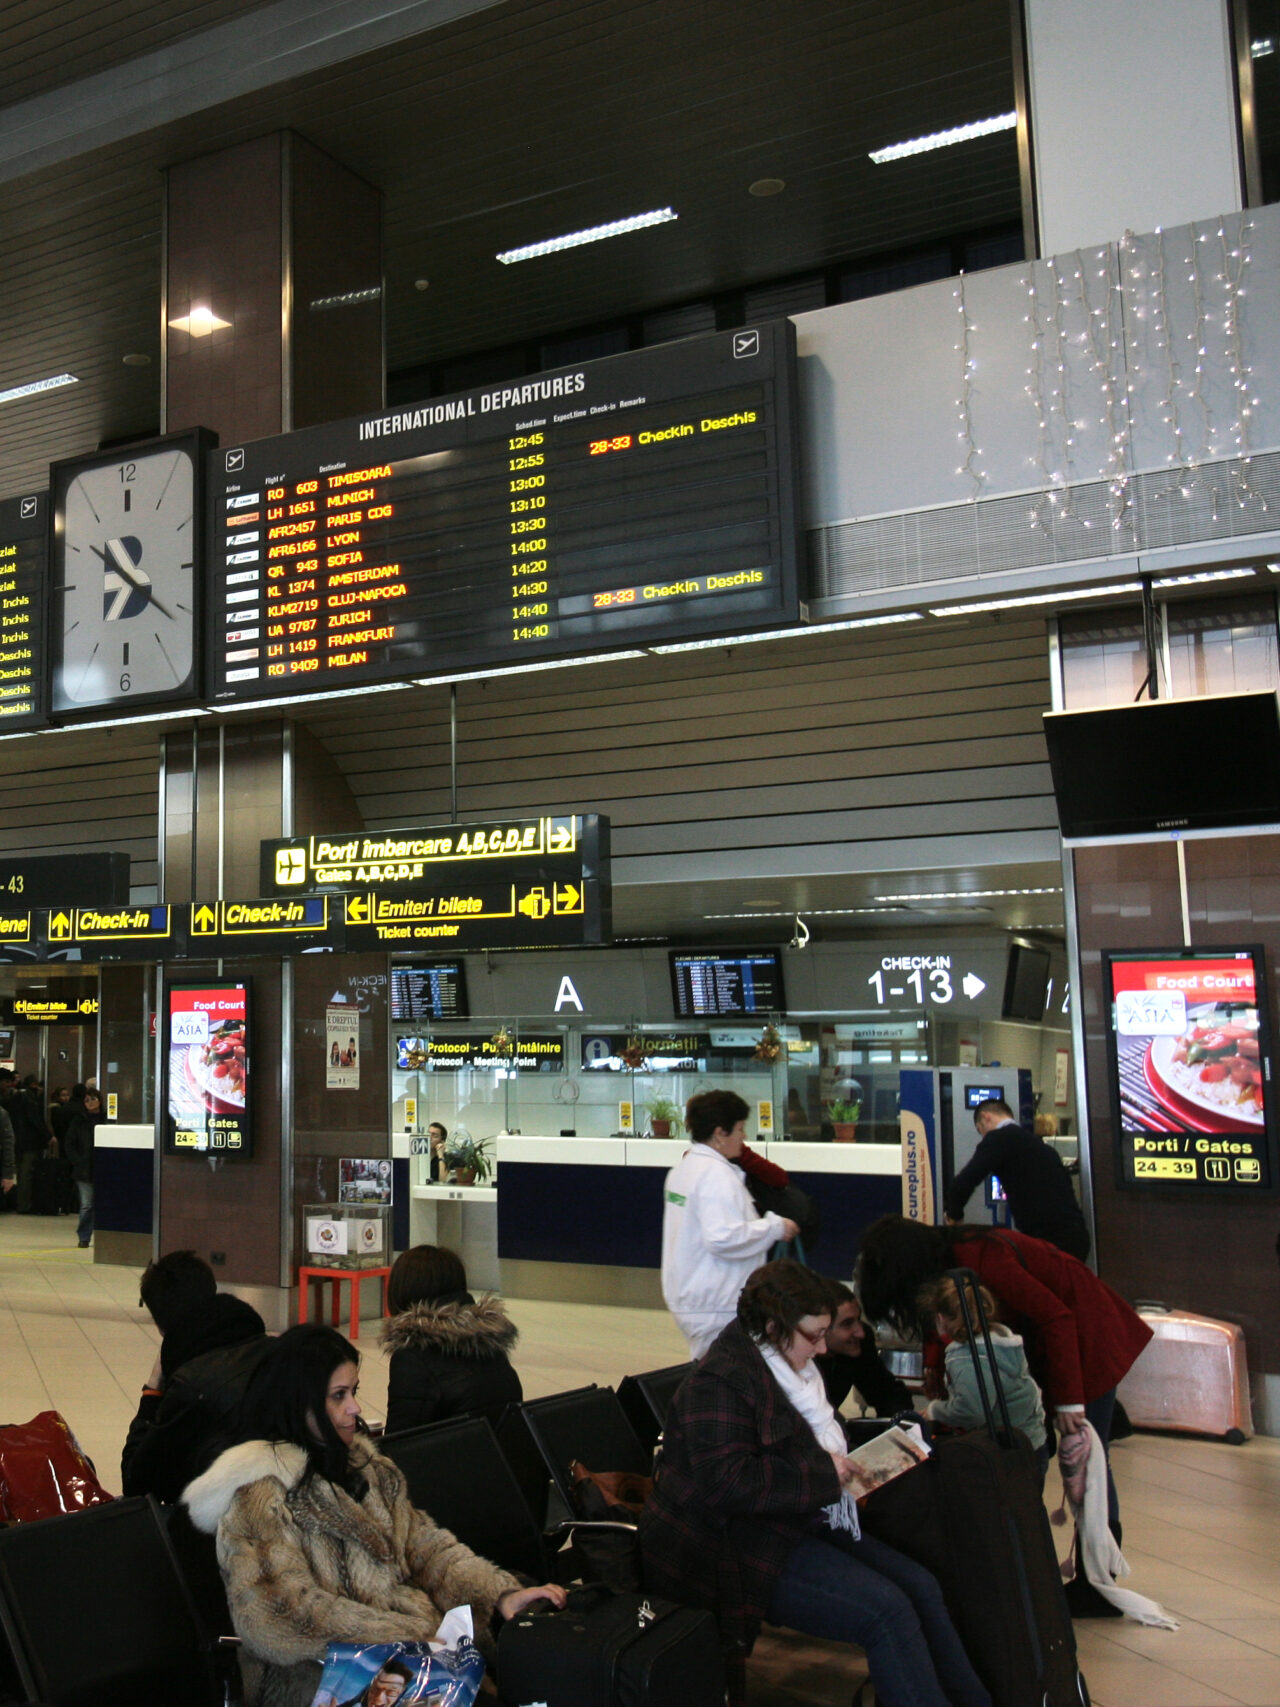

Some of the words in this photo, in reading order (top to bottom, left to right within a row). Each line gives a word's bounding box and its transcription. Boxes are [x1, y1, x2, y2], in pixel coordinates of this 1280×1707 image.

[360, 399, 475, 440] INTERNATIONAL
[481, 373, 585, 413] DEPARTURES
[320, 462, 346, 473] Destination
[619, 397, 646, 408] Remarks
[118, 464, 136, 483] 12
[268, 508, 282, 520] LH
[289, 501, 315, 515] 1651
[328, 489, 374, 507] MUNICH
[510, 454, 544, 470] 12:55
[590, 436, 630, 454] 28-33
[701, 412, 756, 431] Deschis
[268, 488, 284, 500] RO
[297, 481, 317, 494] 603
[328, 464, 391, 488] TIMISOARA
[510, 433, 543, 450] 12:45
[269, 520, 315, 539] AFR2457
[327, 511, 361, 527] PARIS
[368, 505, 392, 519] CDG
[511, 475, 544, 492] 13:00
[269, 540, 316, 558] AFR6166
[328, 531, 359, 547] LYON
[511, 497, 545, 512] 13:10
[296, 560, 318, 572] 943
[328, 552, 362, 567] SOFIA
[511, 518, 545, 533] 13:30
[268, 586, 281, 597] KL
[289, 579, 315, 593] 1374
[328, 564, 399, 587] AMSTERDAM
[512, 539, 546, 554] 14:00
[268, 599, 318, 617] KLM2719
[328, 584, 406, 607] CLUJ-NAPOCA
[512, 560, 546, 576] 14:20
[268, 625, 283, 636] UA
[289, 619, 316, 633] 9787
[328, 610, 370, 627] ZURICH
[513, 582, 547, 597] 14:30
[268, 644, 283, 656] LH
[290, 639, 316, 653] 1419
[328, 627, 394, 647] FRANKFURT
[513, 604, 547, 619] 14:40
[594, 589, 636, 607] 28-33
[707, 571, 763, 589] Deschis
[268, 663, 285, 676] RO
[290, 659, 318, 672] 9409
[328, 652, 366, 667] MILAN
[514, 625, 548, 640] 14:40
[120, 673, 131, 692] 6
[362, 837, 452, 859] îmbarcare
[456, 828, 536, 855] A,B,C,D,E
[315, 868, 352, 882] Gates
[355, 864, 423, 882] A,B,C,D,E
[8, 875, 24, 893] 43
[227, 902, 304, 924] Check-in
[377, 899, 432, 917] Emiteri
[437, 896, 483, 915] bilete
[80, 909, 149, 930] Check-in
[376, 925, 411, 939] Ticket
[414, 924, 460, 938] counter
[882, 955, 951, 971] CHECK-IN
[868, 969, 953, 1004] 1-13
[1157, 976, 1197, 989] Food
[1203, 974, 1253, 988] Court
[554, 975, 584, 1012] A
[194, 1001, 216, 1010] Food
[218, 1000, 245, 1010] Court
[1128, 1009, 1174, 1023] ASIA
[177, 1025, 203, 1036] ASIA
[428, 1042, 470, 1053] Protocol
[482, 1042, 514, 1053] Put
[627, 1037, 699, 1054] Iformații
[428, 1056, 464, 1066] Protocol
[474, 1056, 510, 1068] Meeting
[513, 1056, 537, 1067] Point
[208, 1118, 238, 1129] Gates
[177, 1134, 188, 1143] 24
[1134, 1138, 1178, 1152] Porti
[1195, 1139, 1253, 1154] Gates
[1137, 1161, 1157, 1173] 24
[1173, 1162, 1194, 1174] 39
